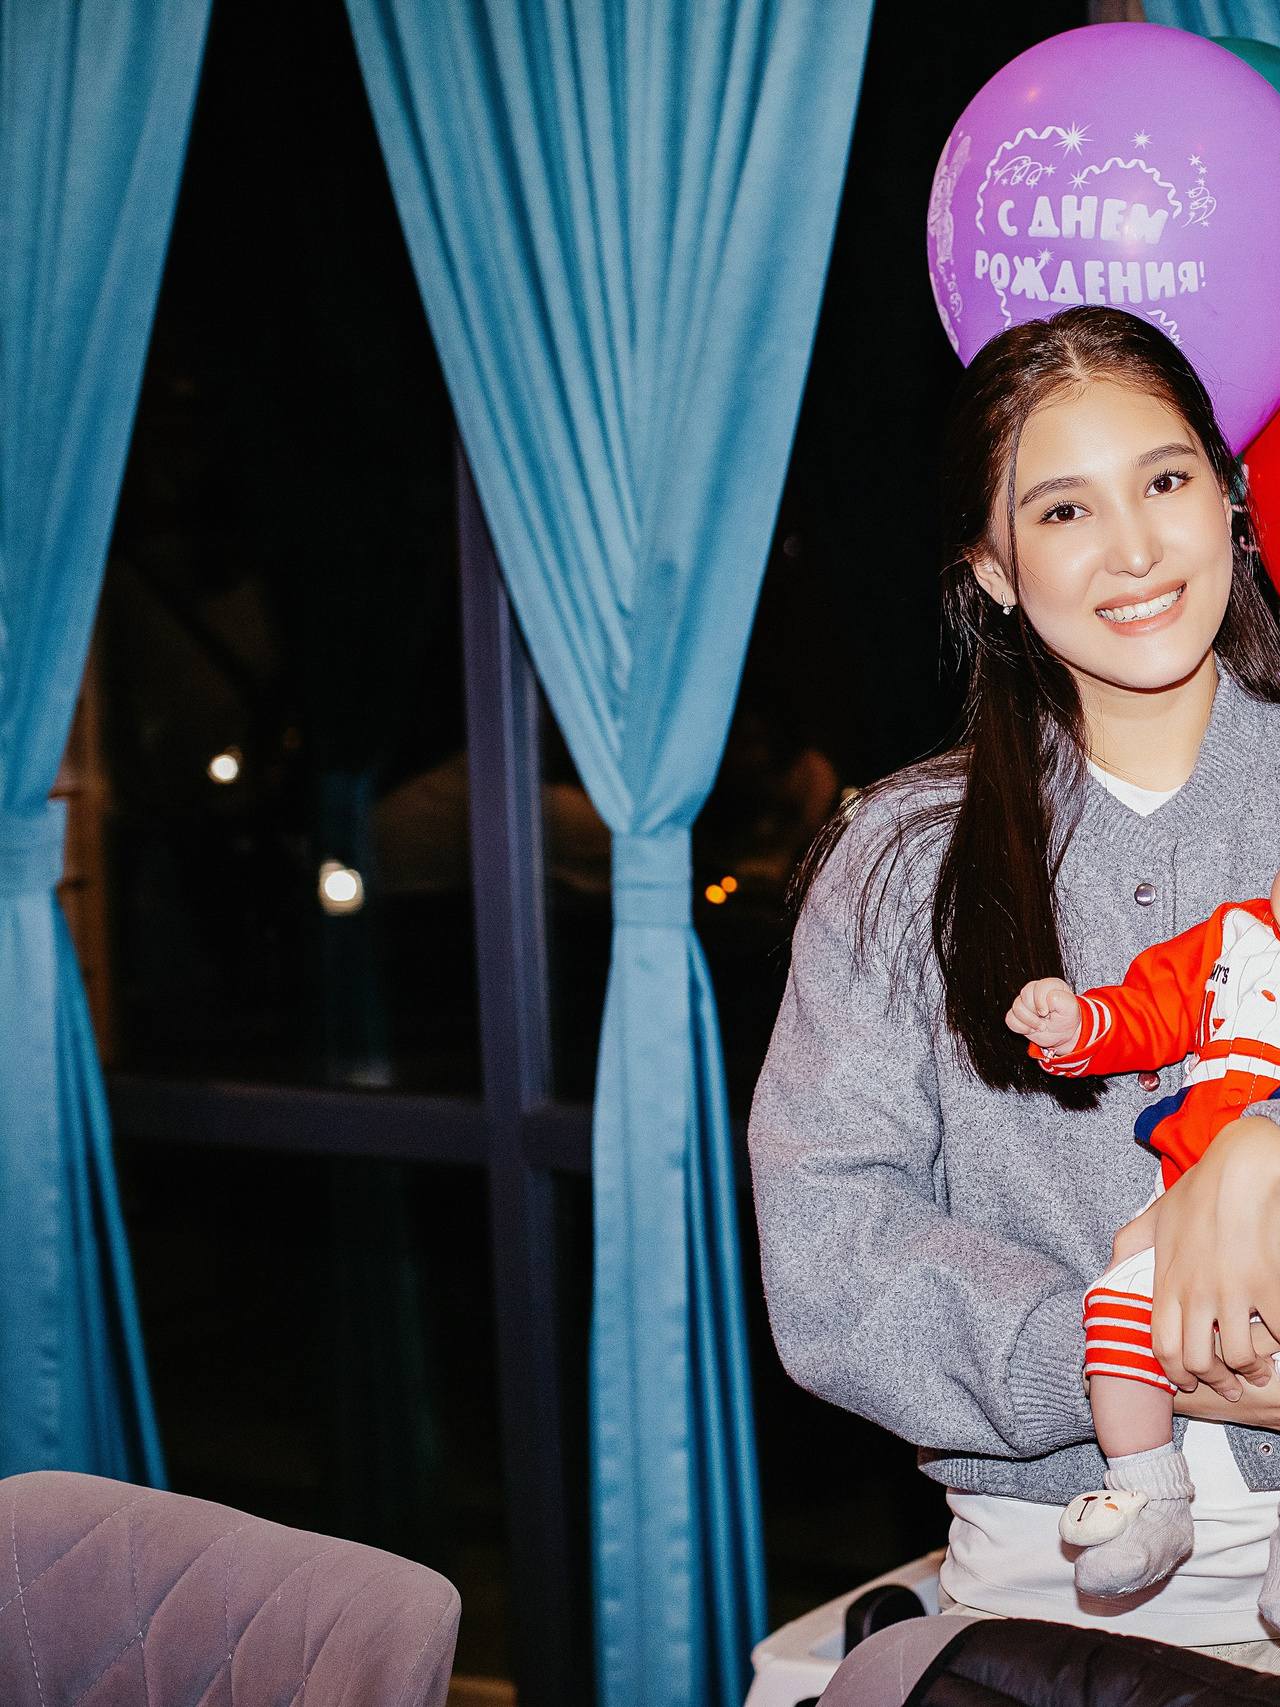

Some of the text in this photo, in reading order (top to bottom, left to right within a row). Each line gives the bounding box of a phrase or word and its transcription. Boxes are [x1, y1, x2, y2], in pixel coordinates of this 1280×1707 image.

[998, 195, 1169, 244] С ДНЕМ
[974, 250, 1206, 305] РОЖДЕНИЯ!
